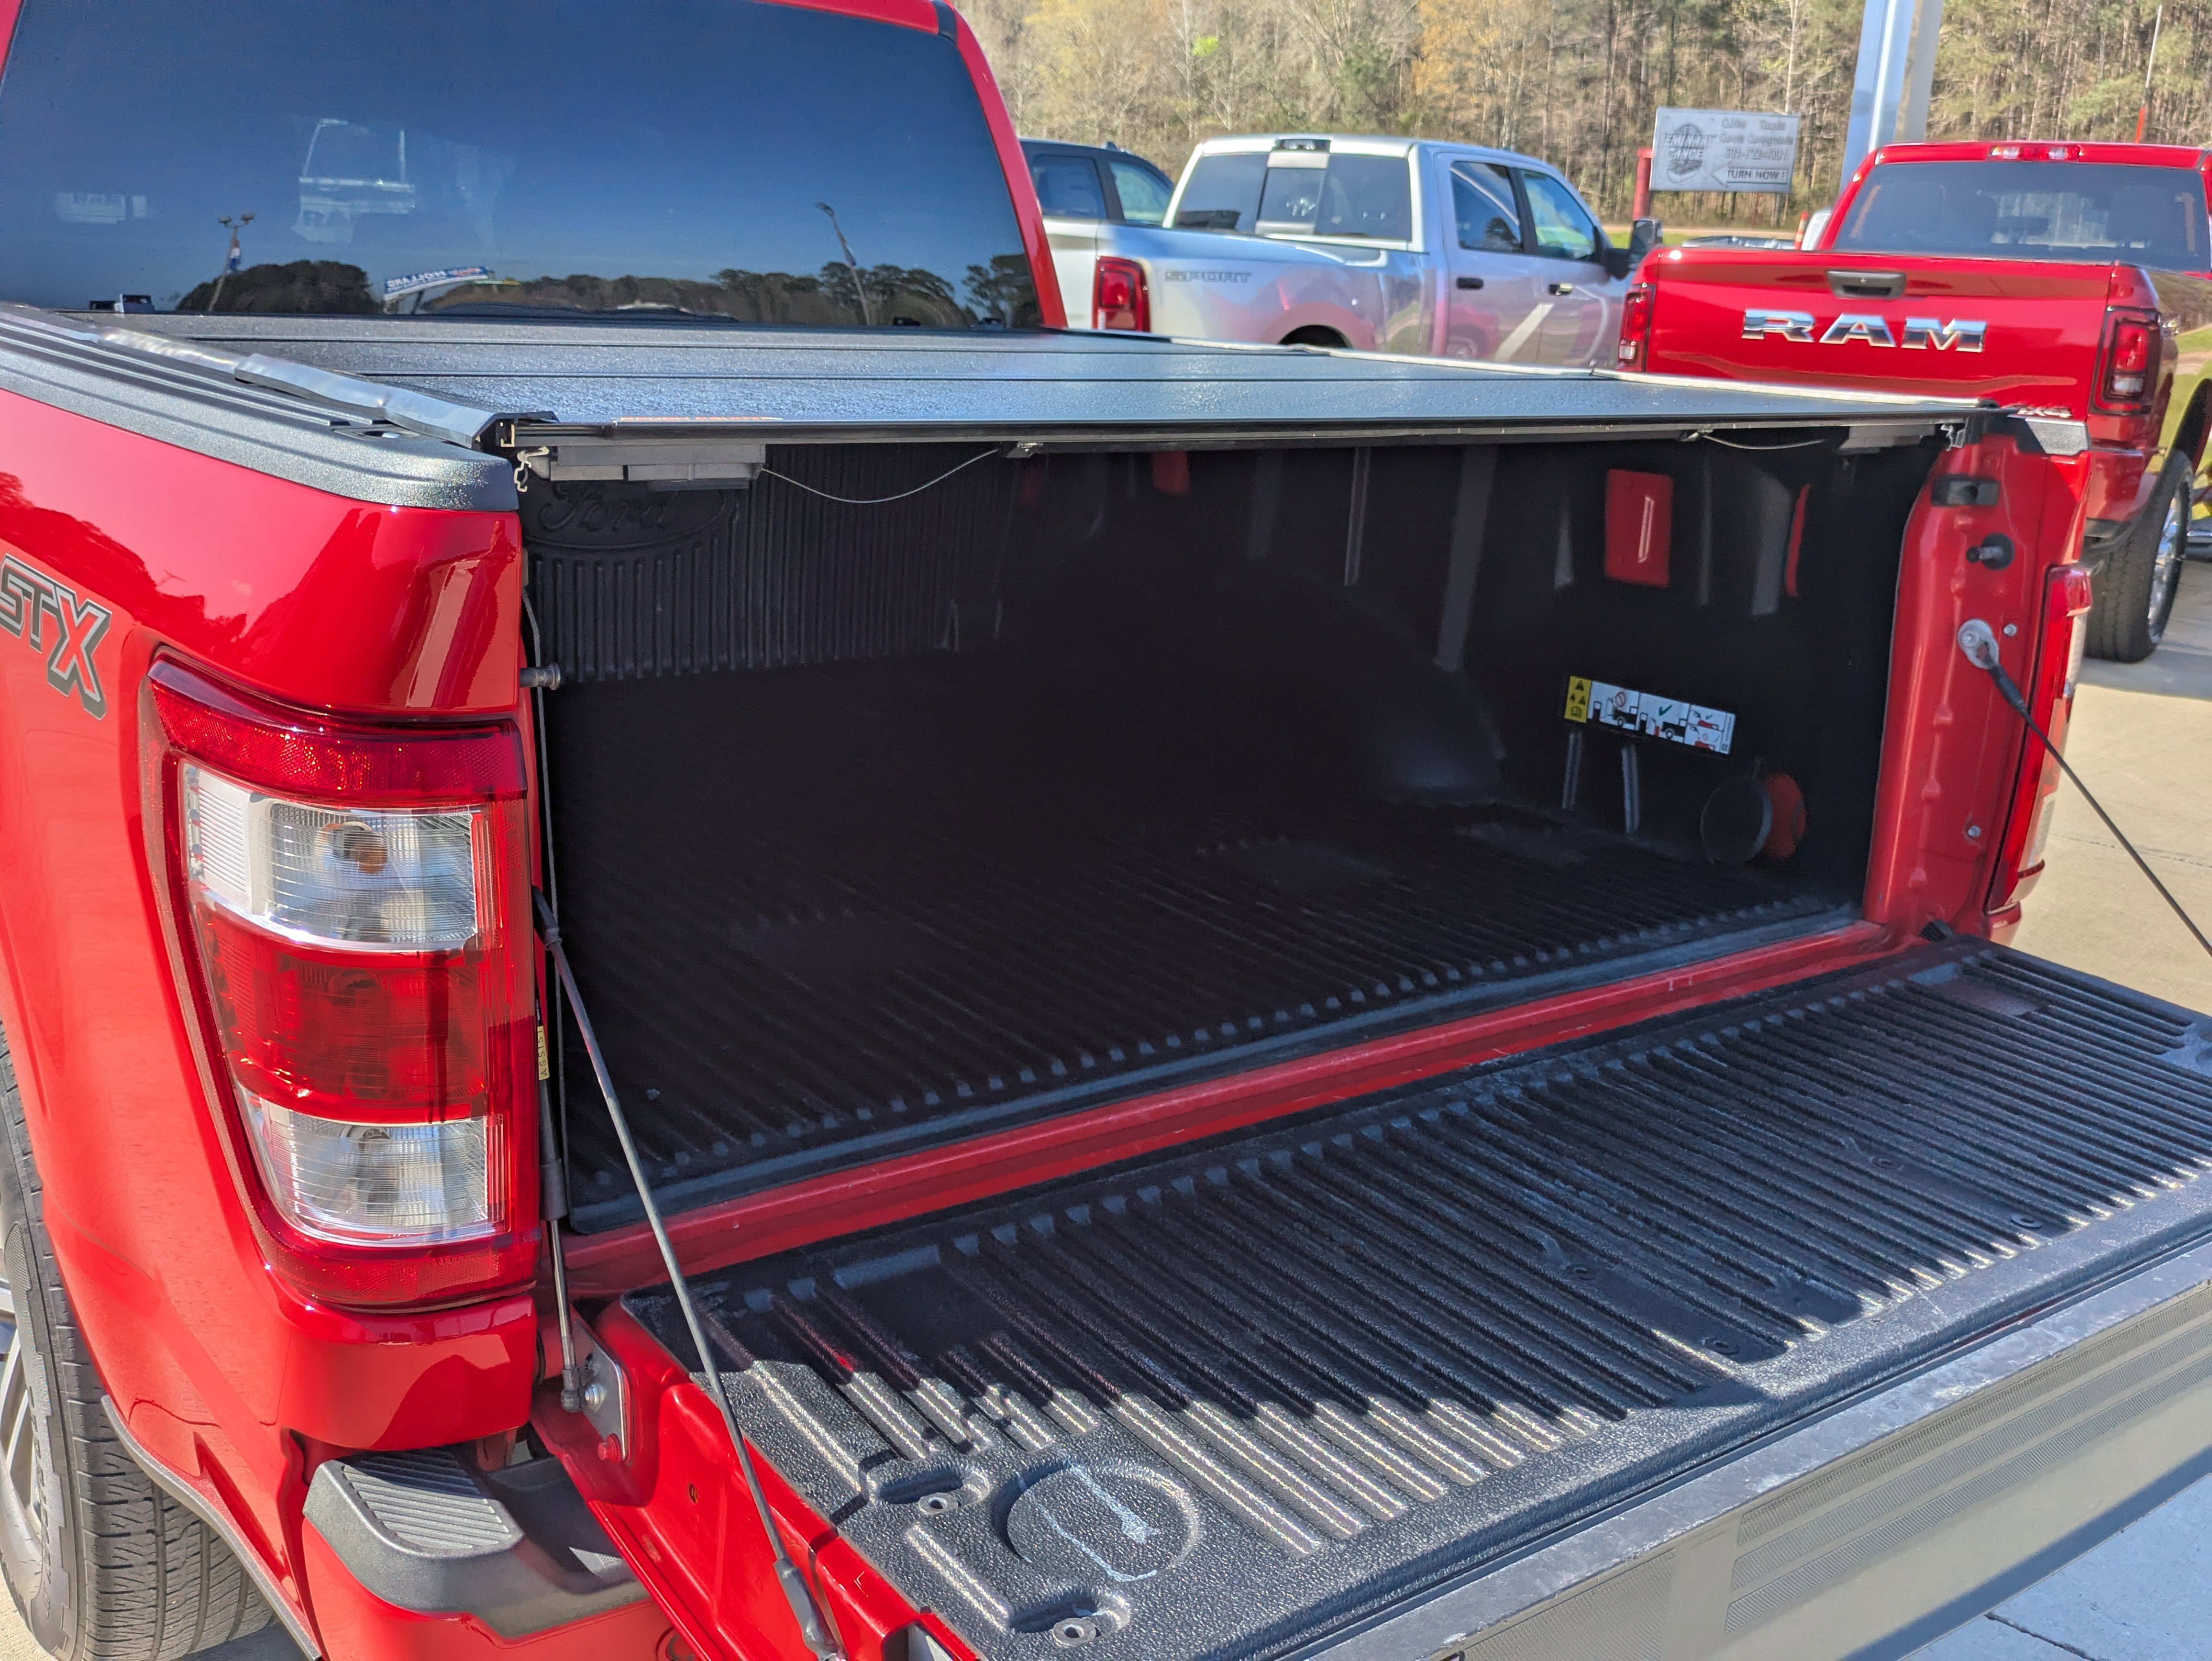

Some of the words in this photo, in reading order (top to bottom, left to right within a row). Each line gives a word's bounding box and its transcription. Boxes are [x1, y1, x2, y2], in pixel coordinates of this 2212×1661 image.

[1727, 169, 1752, 179] TURN
[1164, 271, 1251, 283] SPORT
[1741, 309, 1987, 353] RAM
[0, 553, 113, 720] STX
